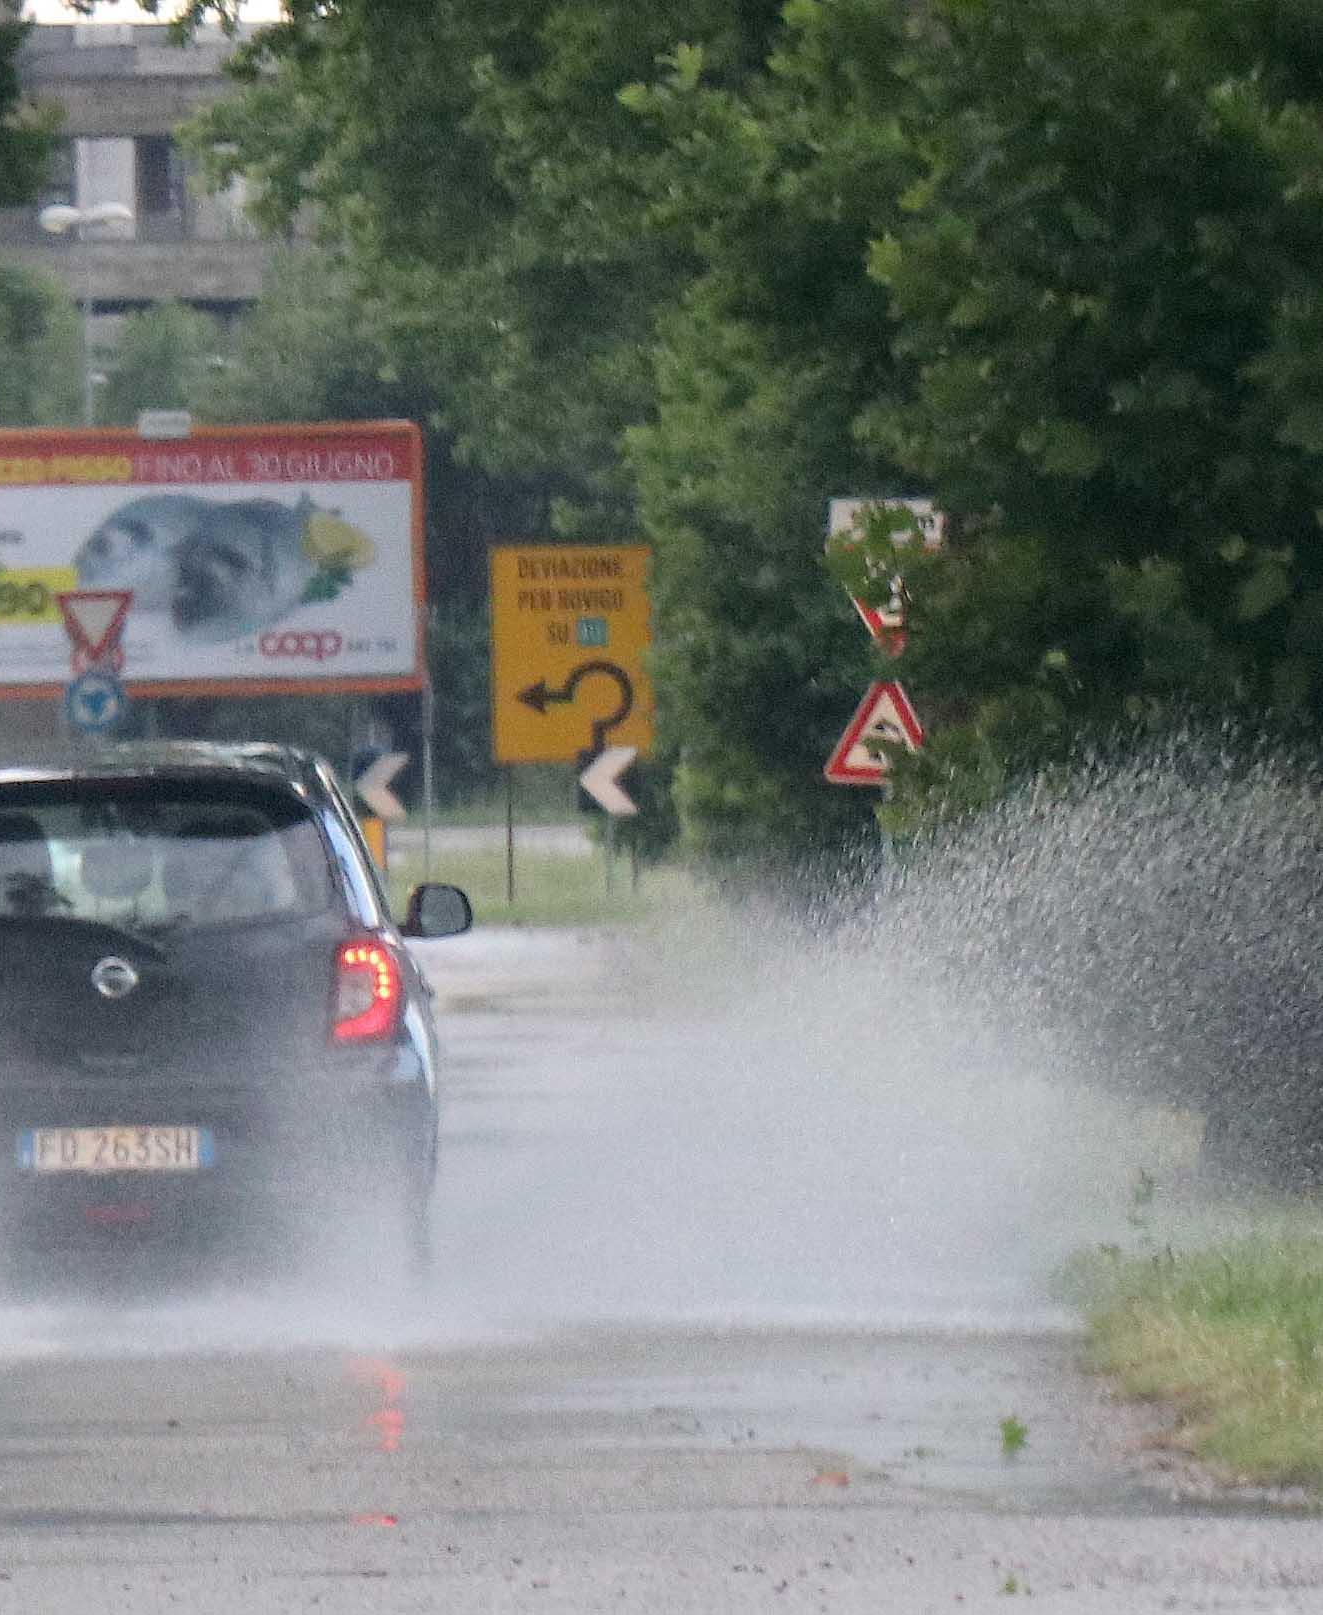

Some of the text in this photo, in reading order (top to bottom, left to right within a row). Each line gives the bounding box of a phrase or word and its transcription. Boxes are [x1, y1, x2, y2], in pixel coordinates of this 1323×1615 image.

[135, 453, 200, 481] FINO
[206, 453, 234, 481] AL
[248, 451, 280, 479] 30
[285, 450, 393, 479] GIUGNO
[518, 555, 624, 579] DEVIAZIONE
[518, 588, 624, 611] PER ROVIGO
[547, 620, 569, 644] SU
[258, 631, 342, 661] coop
